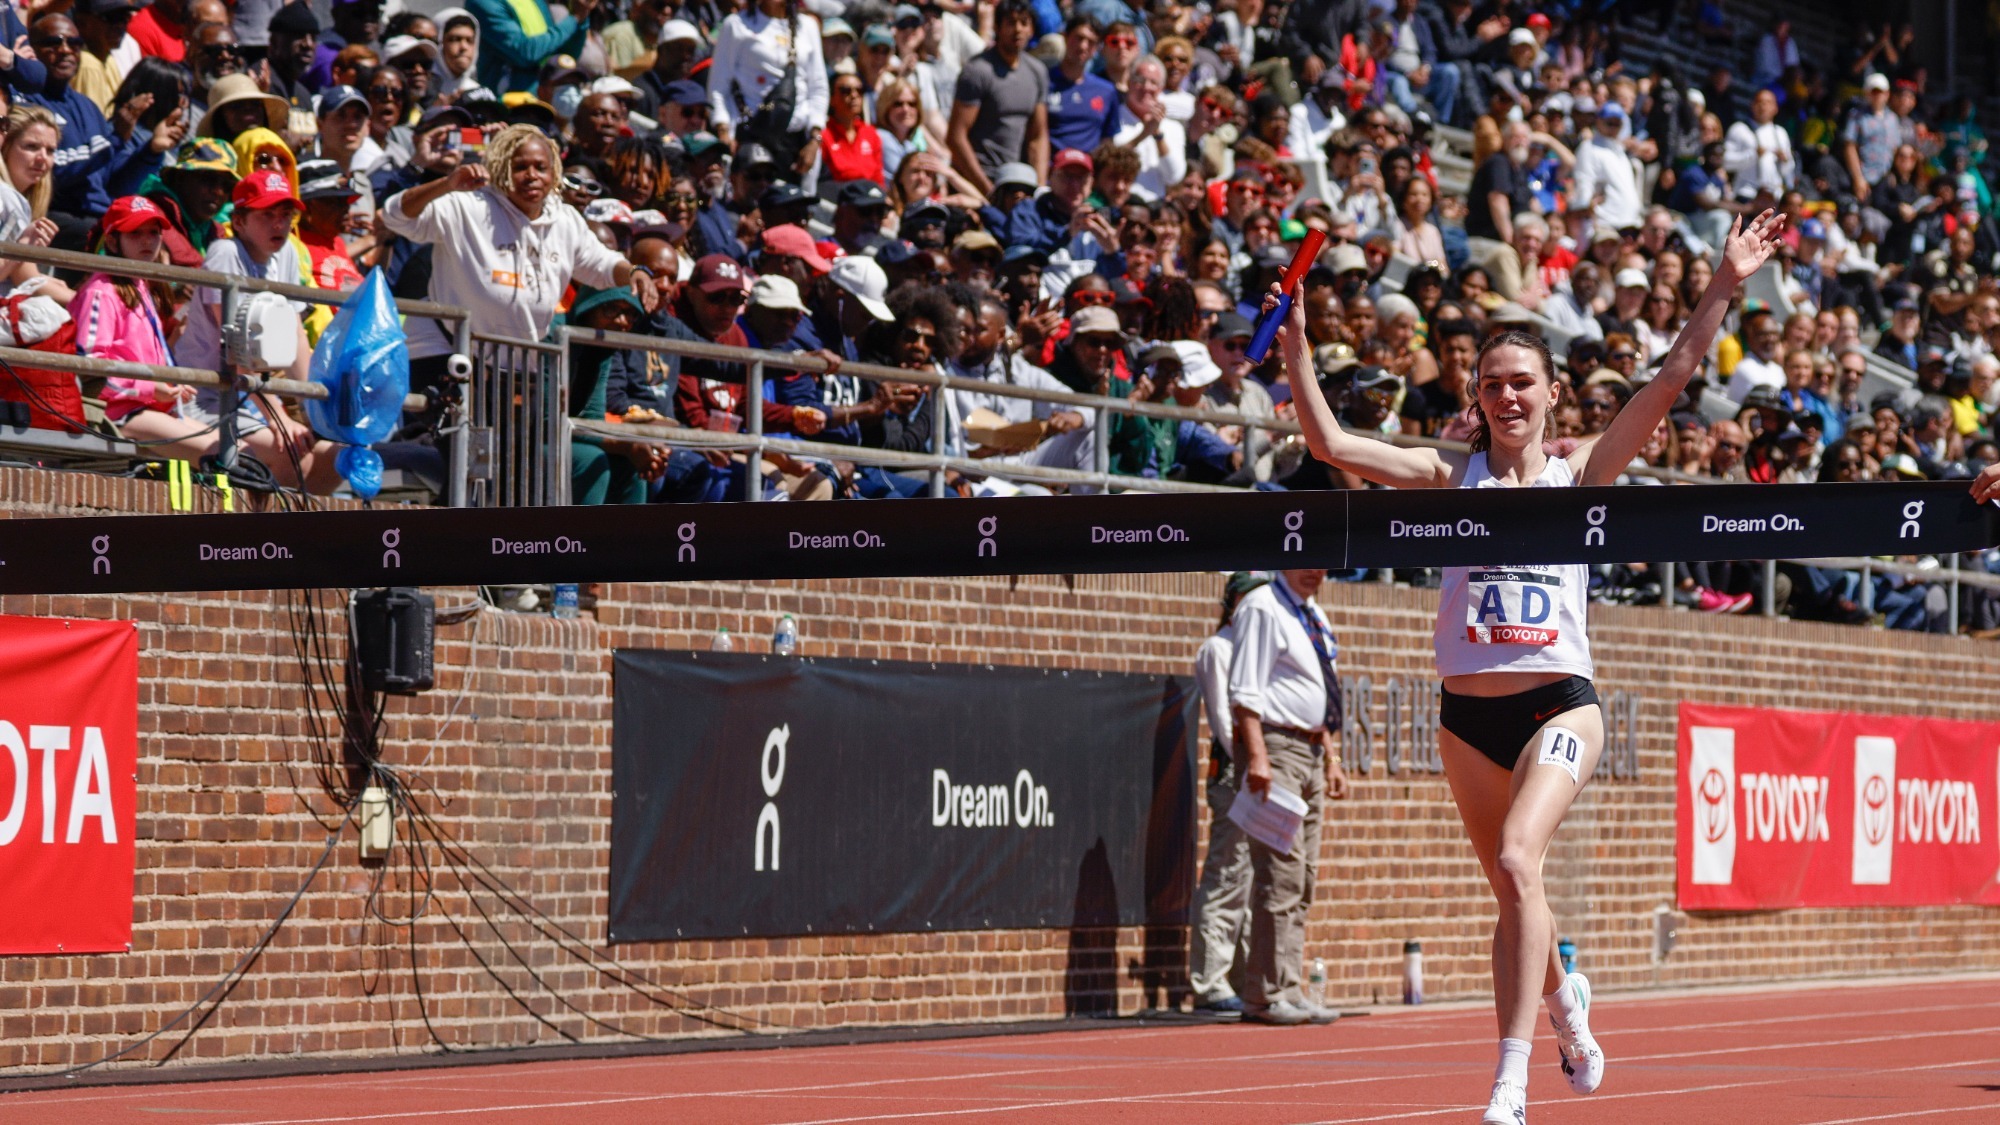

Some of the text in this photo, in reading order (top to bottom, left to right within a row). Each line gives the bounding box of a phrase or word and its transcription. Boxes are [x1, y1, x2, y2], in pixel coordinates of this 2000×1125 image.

[1390, 518, 1490, 538] Dream On.
[1702, 513, 1805, 533] Dream On.
[789, 530, 886, 549] Dream On.
[1091, 525, 1190, 543] Dream On.
[199, 543, 293, 561] Dream On.
[491, 535, 587, 555] Dream On.
[1483, 573, 1507, 582] Dream
[1475, 584, 1551, 624] A D
[1494, 629, 1549, 642] TOYOTA
[1550, 732, 1577, 763] AD
[932, 768, 1056, 828] Dream On.
[1740, 771, 1831, 843] TOYOTA
[1897, 777, 1981, 844] TOYOTA
